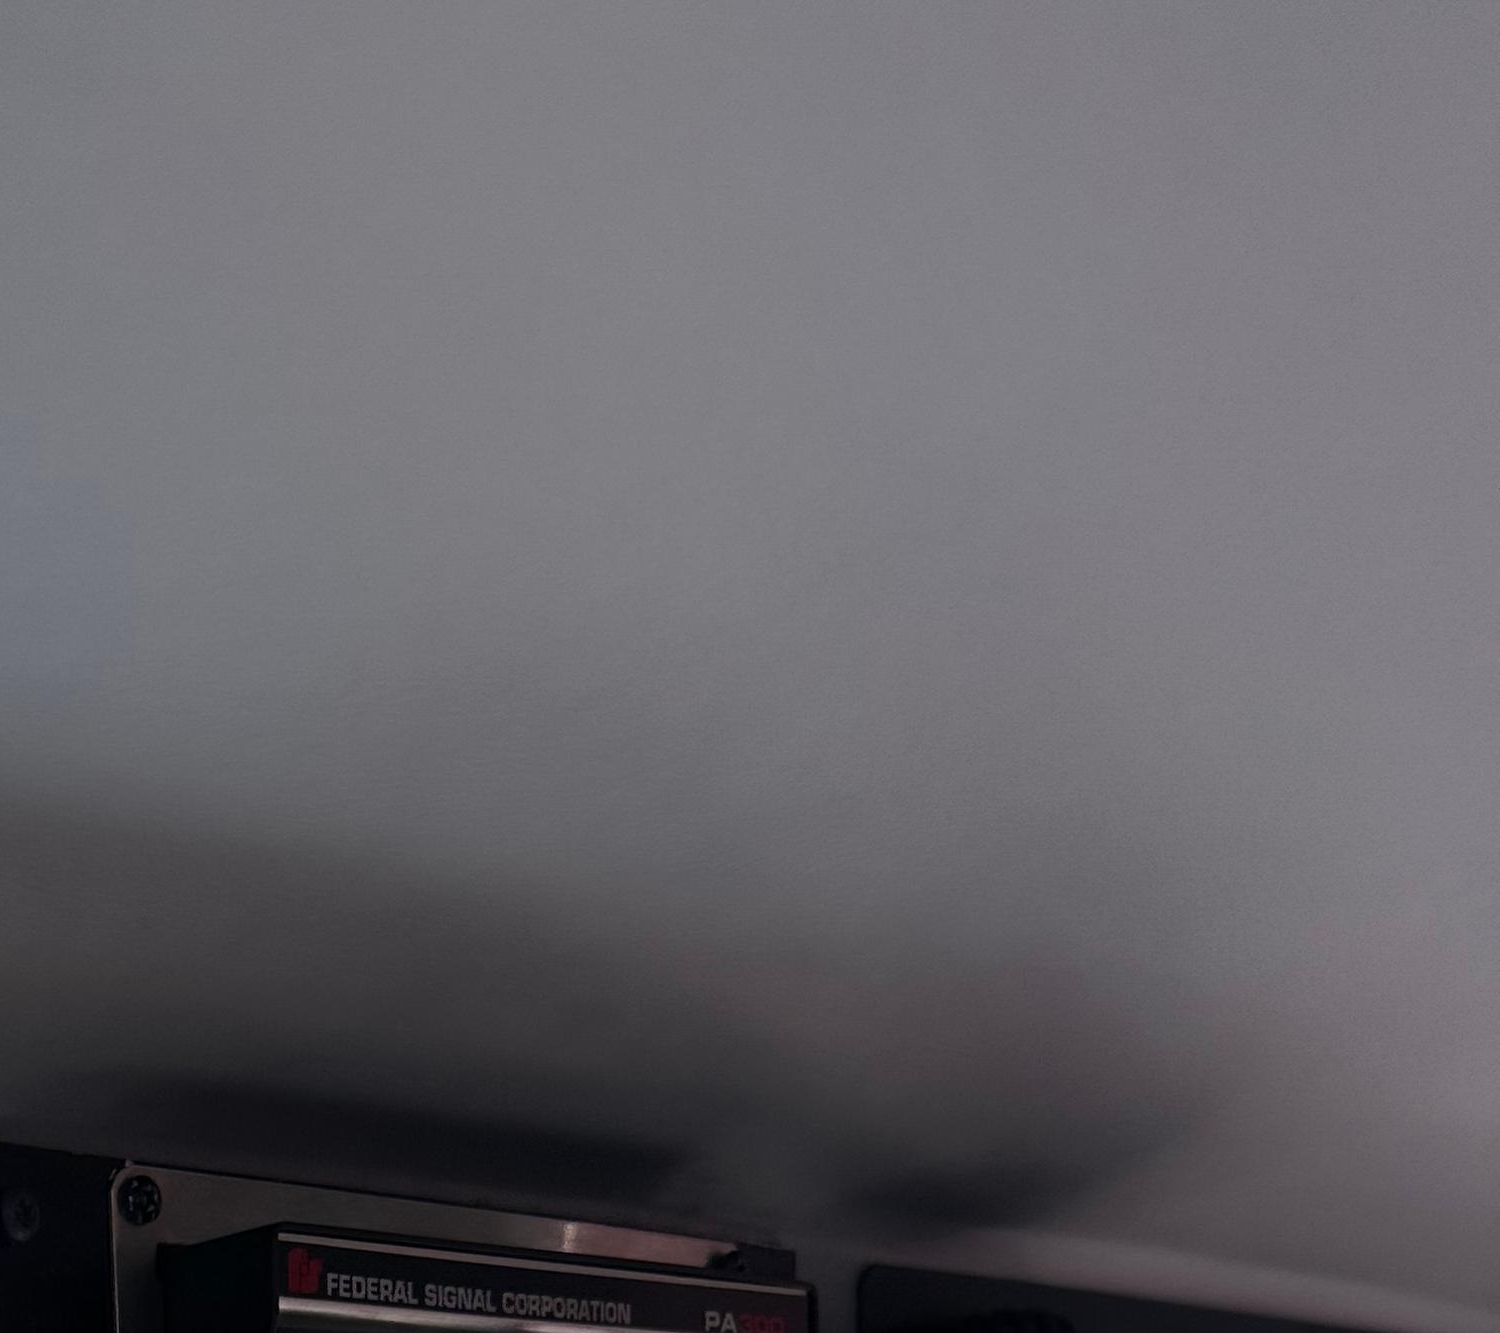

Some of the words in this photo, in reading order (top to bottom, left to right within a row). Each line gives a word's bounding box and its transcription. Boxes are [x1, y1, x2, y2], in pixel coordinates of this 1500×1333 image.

[326, 1272, 419, 1306] FEDERAL
[424, 1283, 497, 1314] SIGNAL
[502, 1291, 632, 1326] CORPORATION
